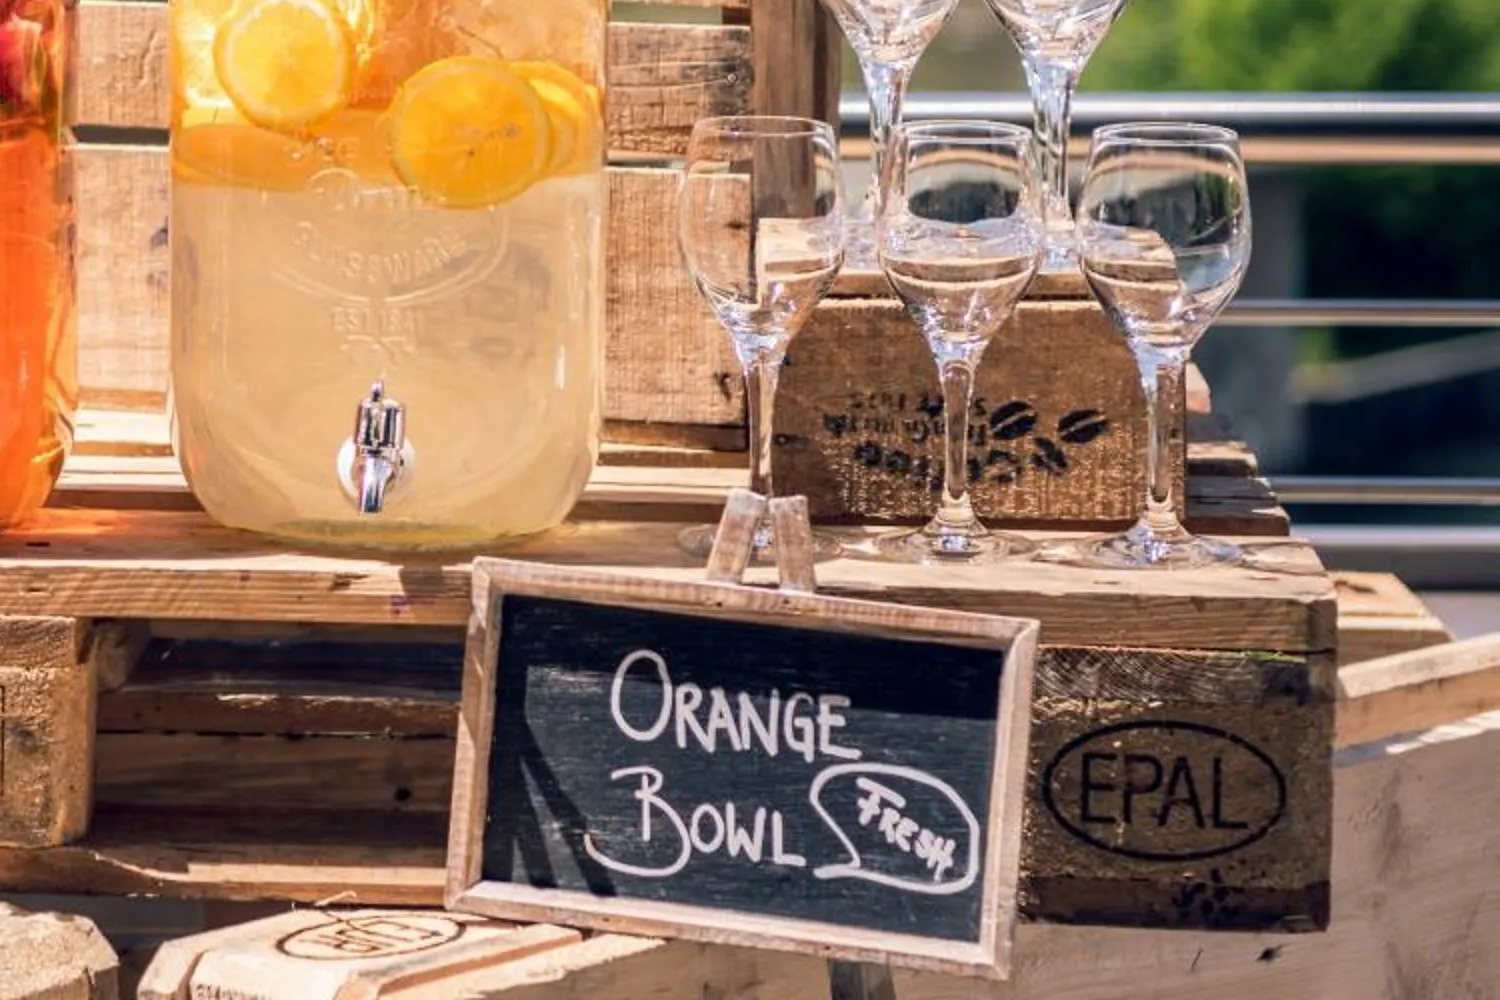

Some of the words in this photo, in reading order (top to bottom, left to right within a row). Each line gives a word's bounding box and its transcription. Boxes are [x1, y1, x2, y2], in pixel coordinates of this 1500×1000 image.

[611, 648, 862, 763] ORANGE
[584, 765, 806, 877] BOWL
[856, 777, 956, 882] FRESH
[1080, 752, 1248, 830] EPAL
